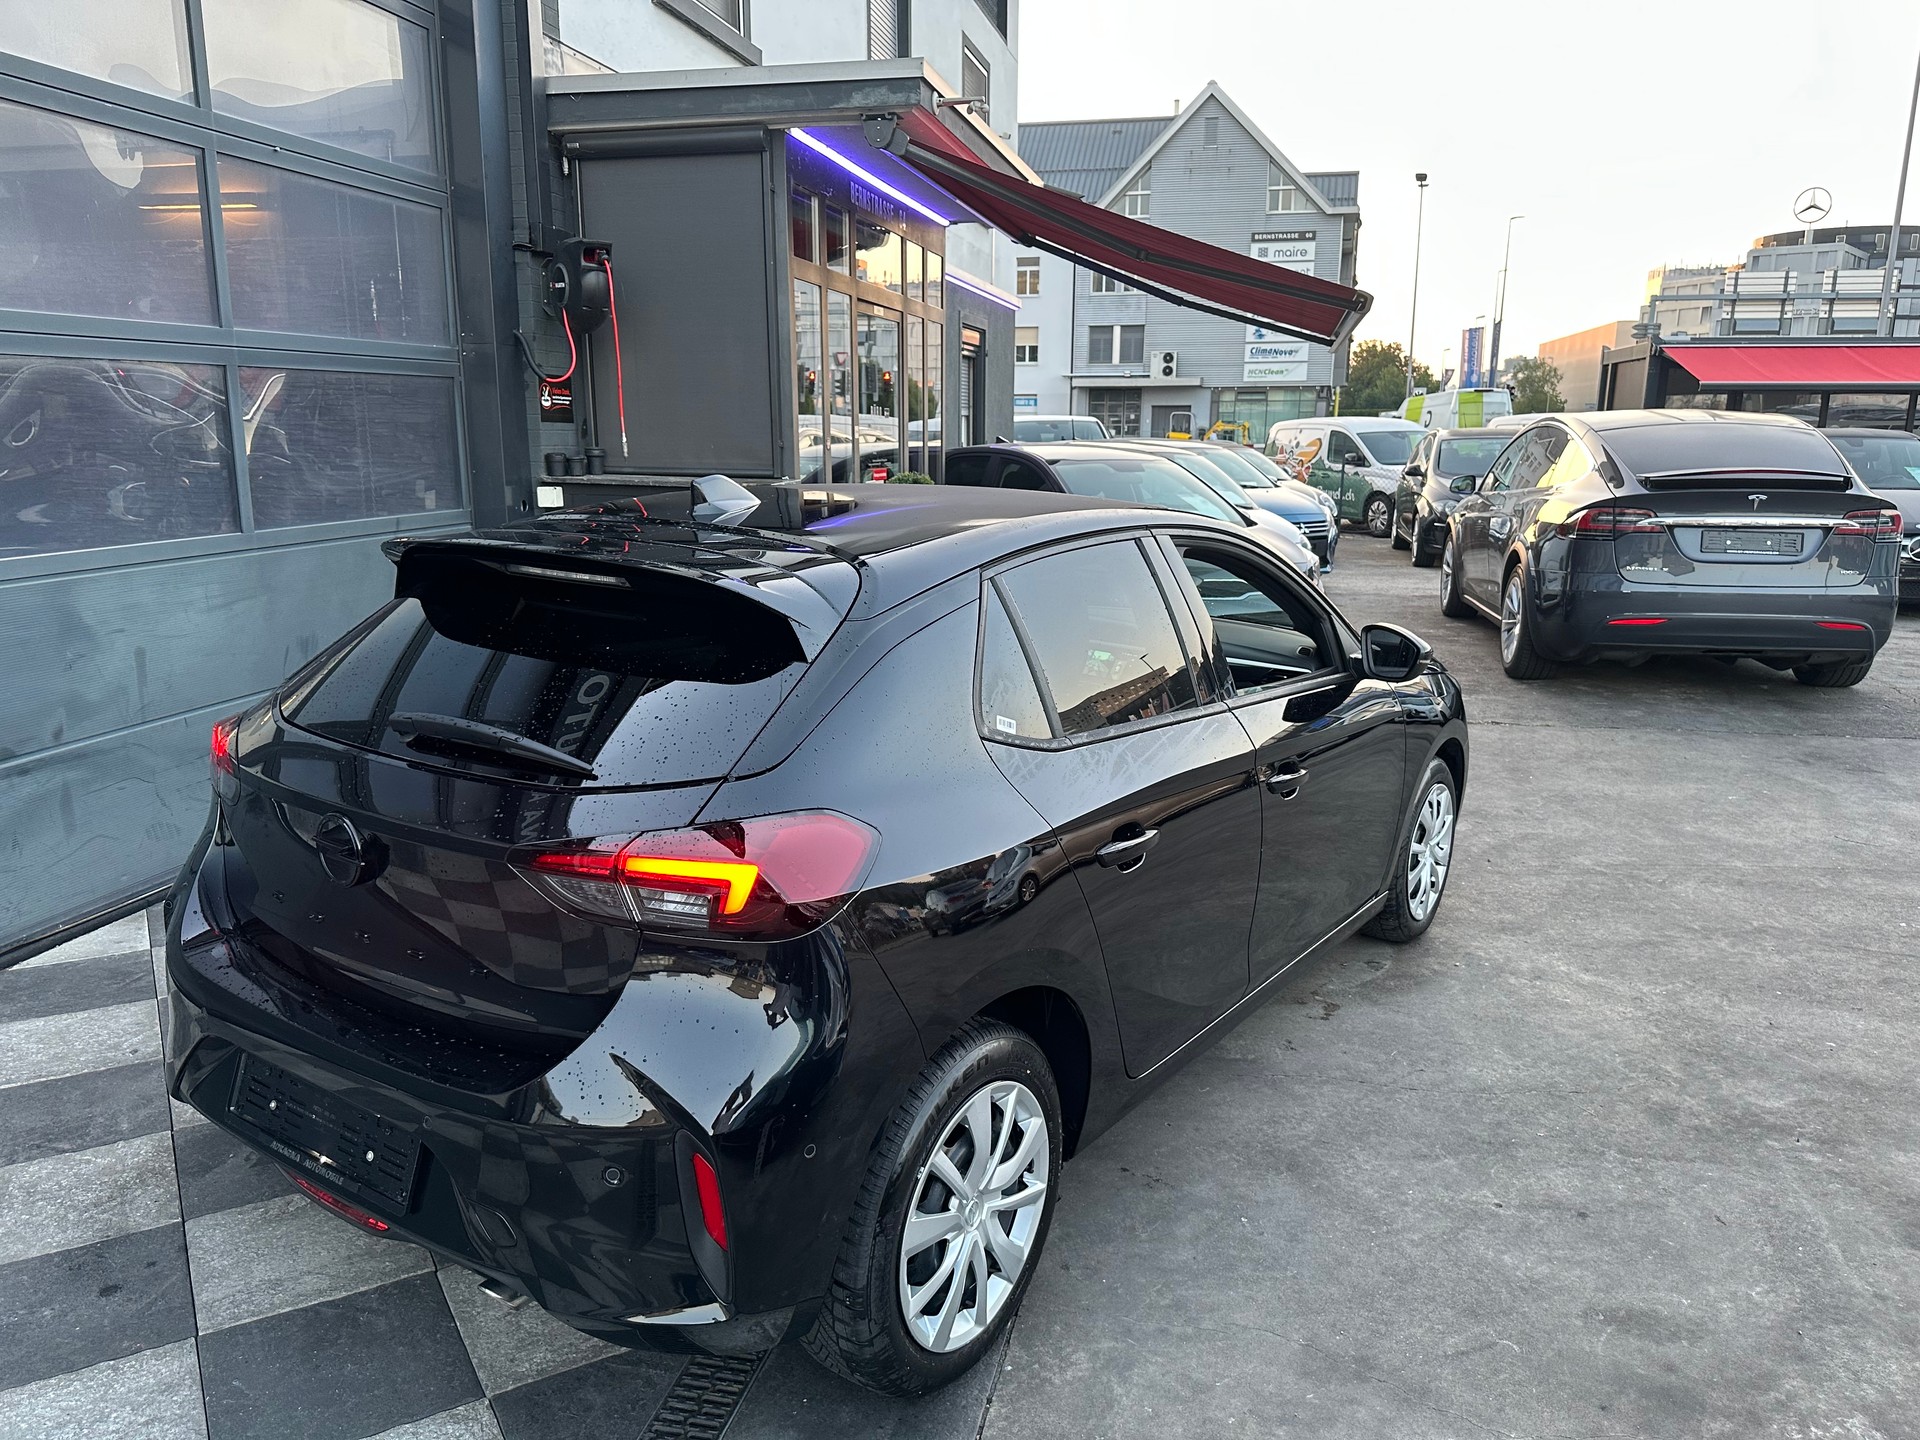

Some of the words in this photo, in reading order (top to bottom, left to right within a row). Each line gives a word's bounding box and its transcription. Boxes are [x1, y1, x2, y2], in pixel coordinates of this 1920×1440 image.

[850, 181, 894, 223] BERNSTRASSE
[1254, 232, 1299, 240] BERNSTRASSE
[1273, 246, 1308, 258] maire
